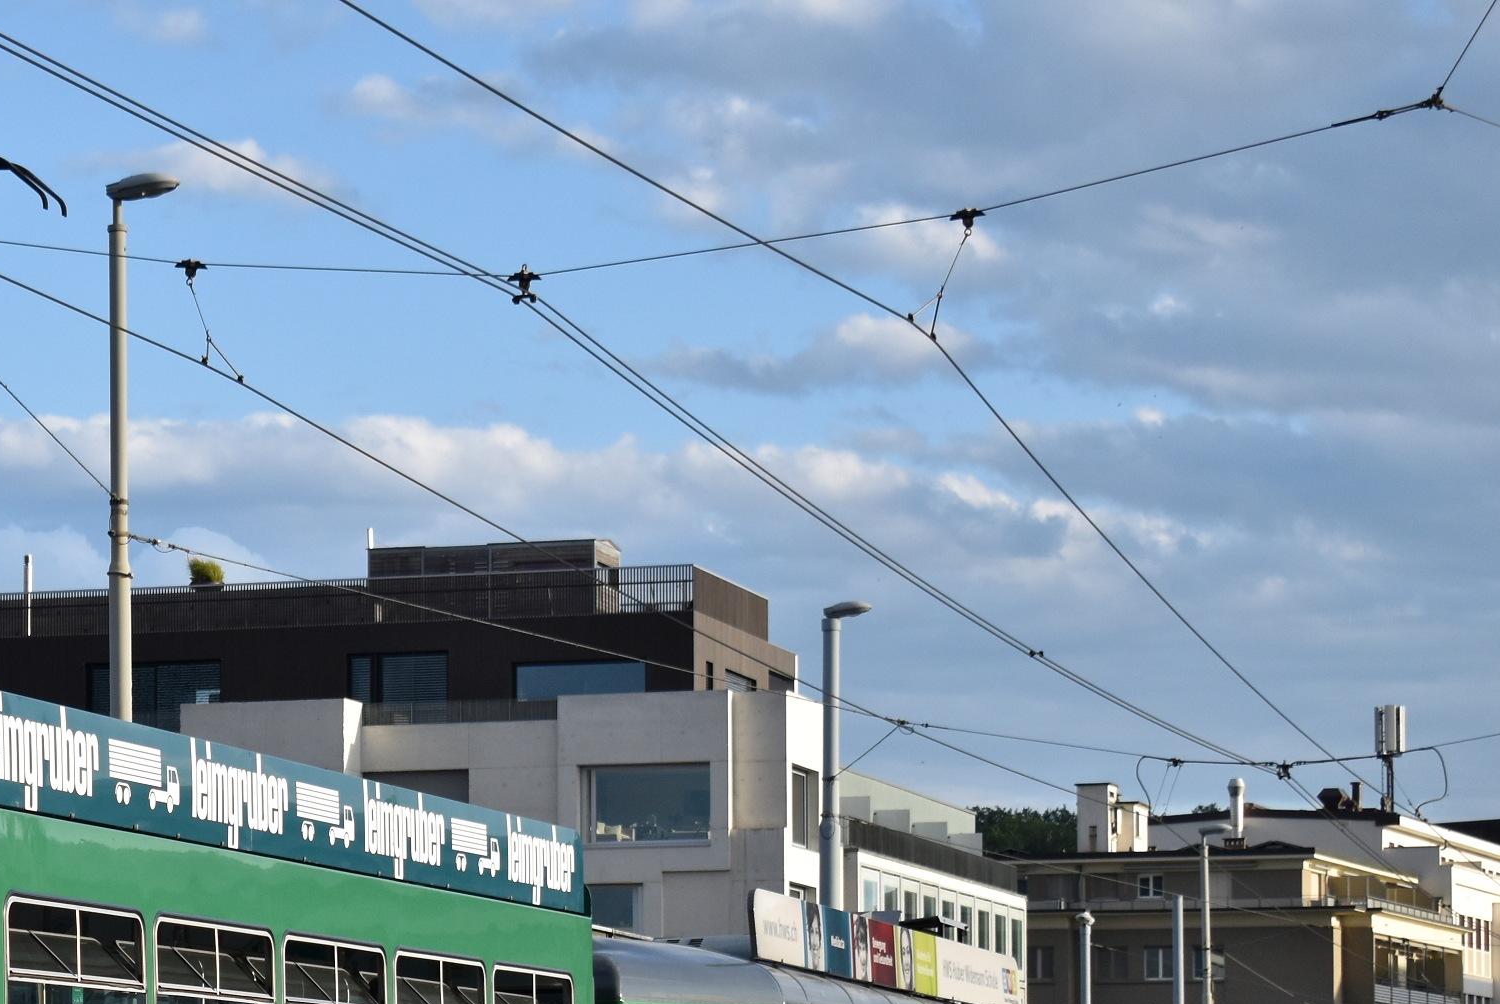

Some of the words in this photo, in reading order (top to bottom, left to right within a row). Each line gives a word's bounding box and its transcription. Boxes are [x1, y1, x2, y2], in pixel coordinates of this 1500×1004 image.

[190, 736, 289, 849] leimgruber
[362, 778, 445, 880] leimgruber
[506, 813, 575, 906] leimgruber
